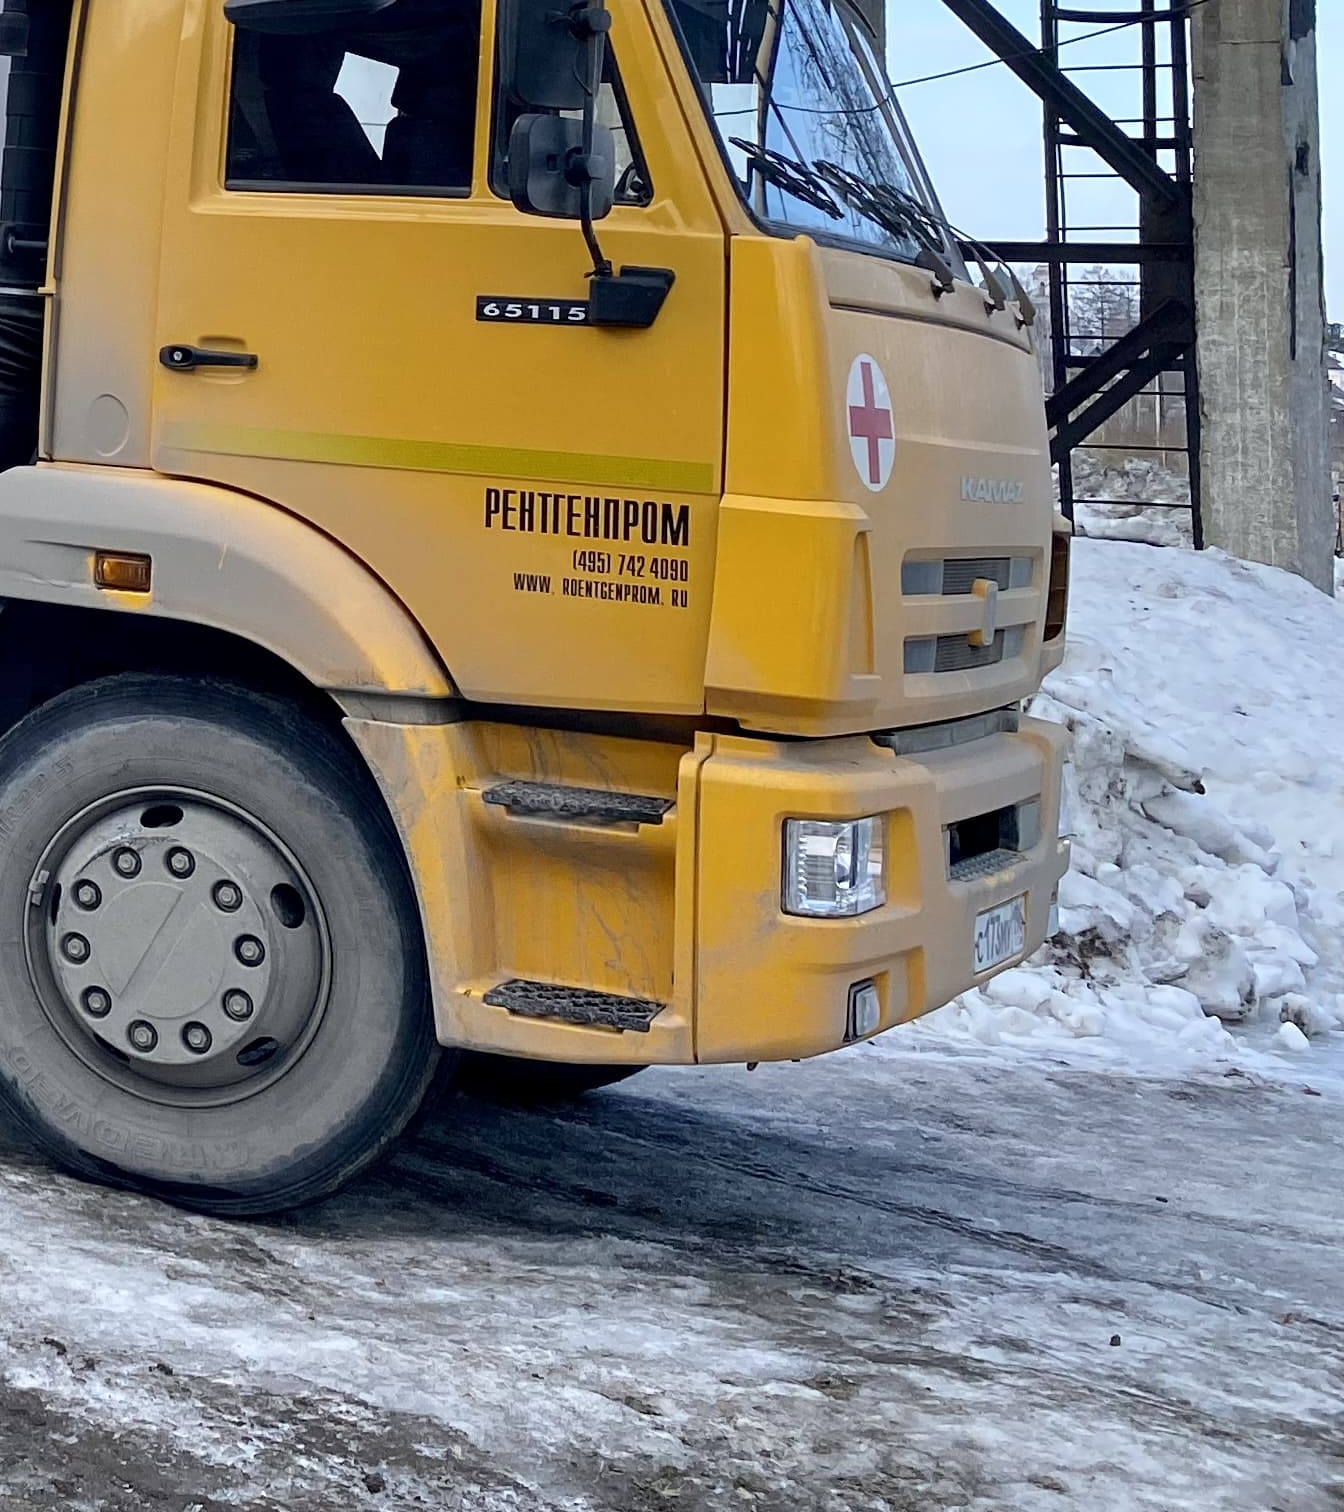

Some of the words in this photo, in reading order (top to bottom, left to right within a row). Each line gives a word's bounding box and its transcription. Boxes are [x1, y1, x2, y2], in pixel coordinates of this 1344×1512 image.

[482, 302, 587, 322] 65115
[485, 487, 690, 547] РЕНТГЕНПРОМ
[572, 549, 611, 574] (495)
[617, 553, 646, 578] 742
[649, 557, 689, 582] 4090
